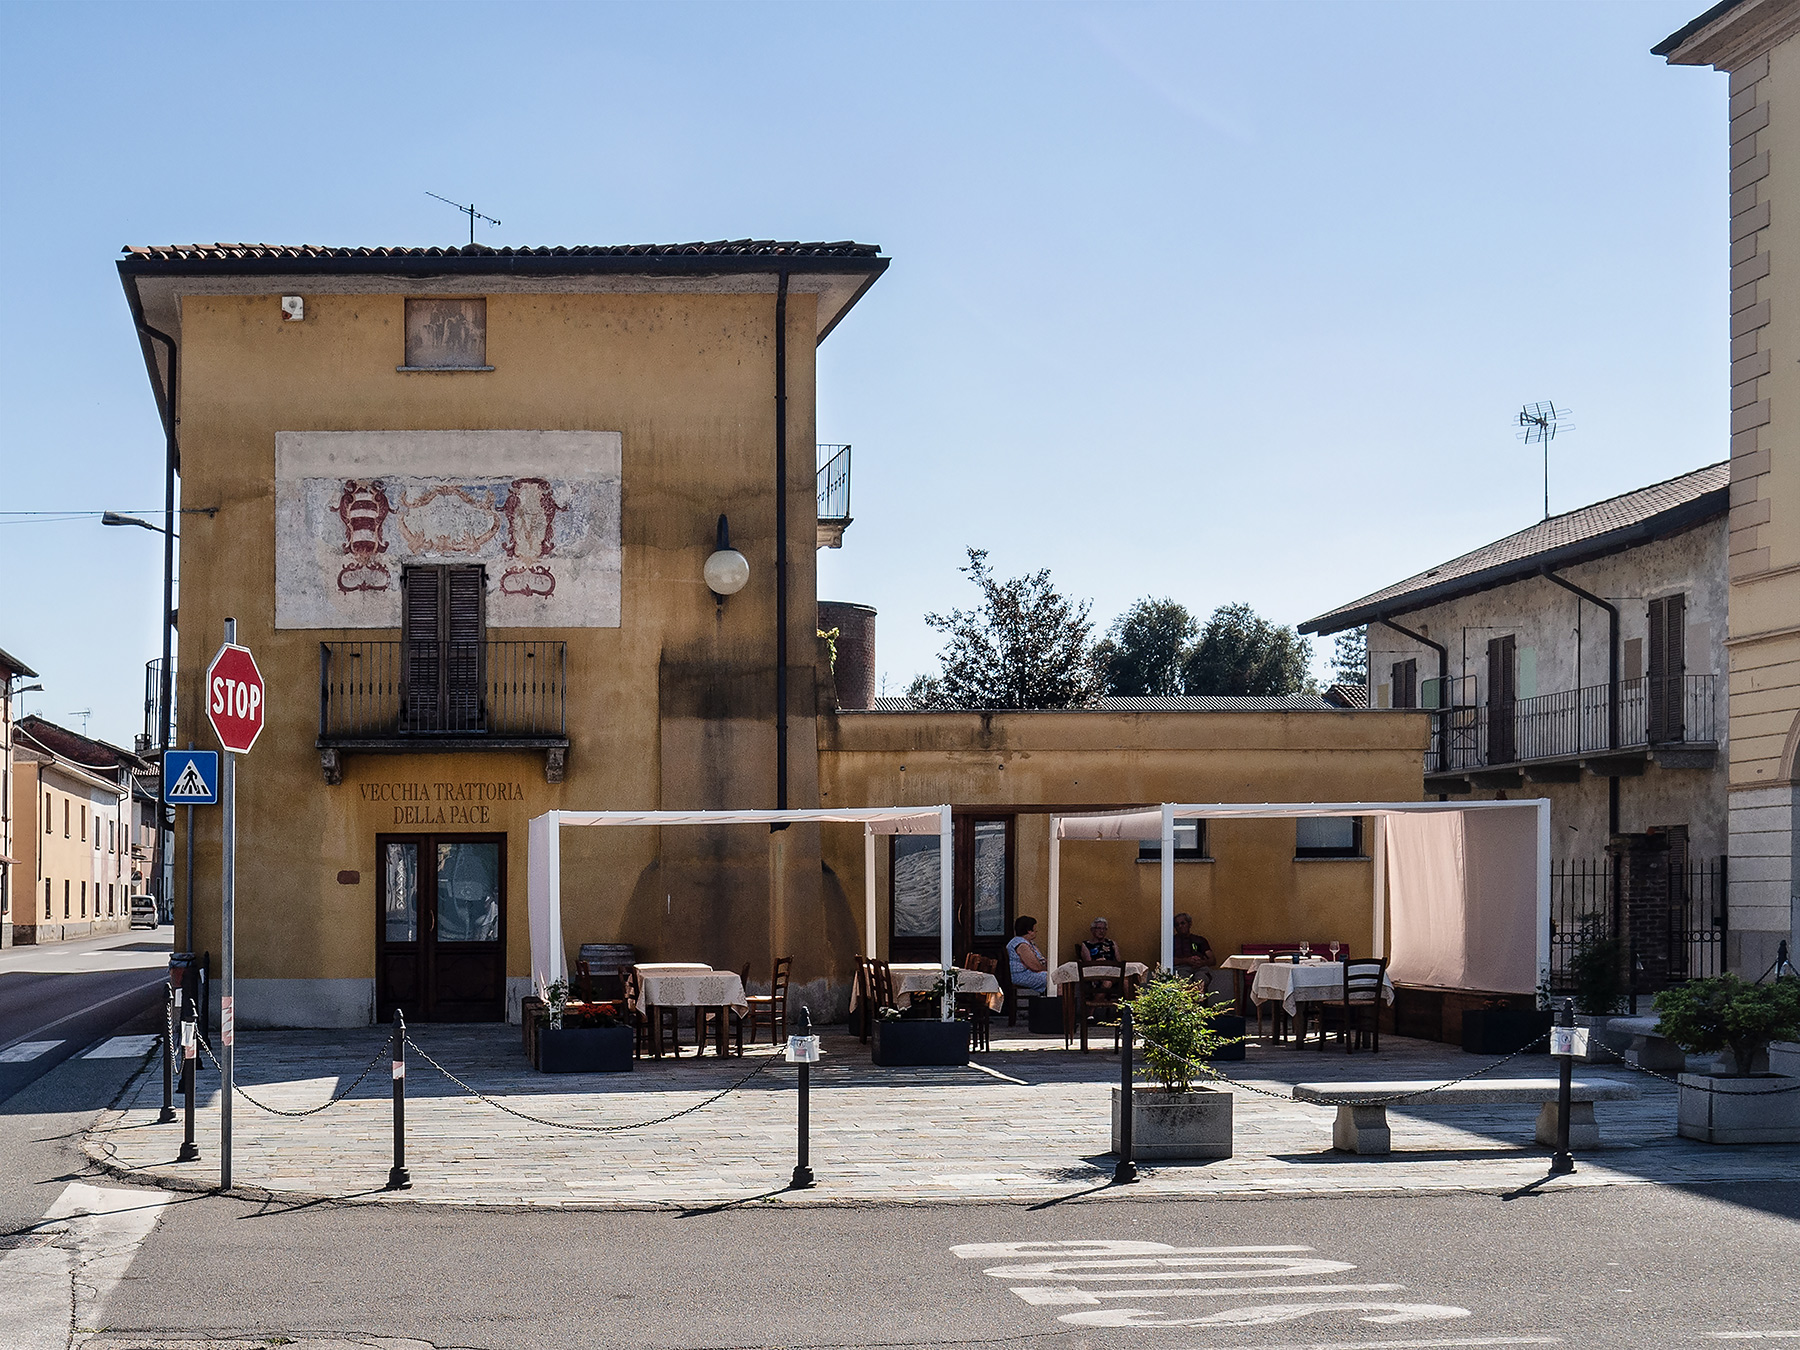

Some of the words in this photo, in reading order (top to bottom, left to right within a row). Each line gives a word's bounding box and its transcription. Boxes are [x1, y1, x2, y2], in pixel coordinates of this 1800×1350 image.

[212, 676, 261, 721] STOP
[359, 783, 431, 801] VECCHIA
[434, 782, 524, 801] TRATTORIA
[394, 806, 446, 825] DELLA
[450, 805, 490, 824] PACE
[949, 1240, 1471, 1327] STOP
